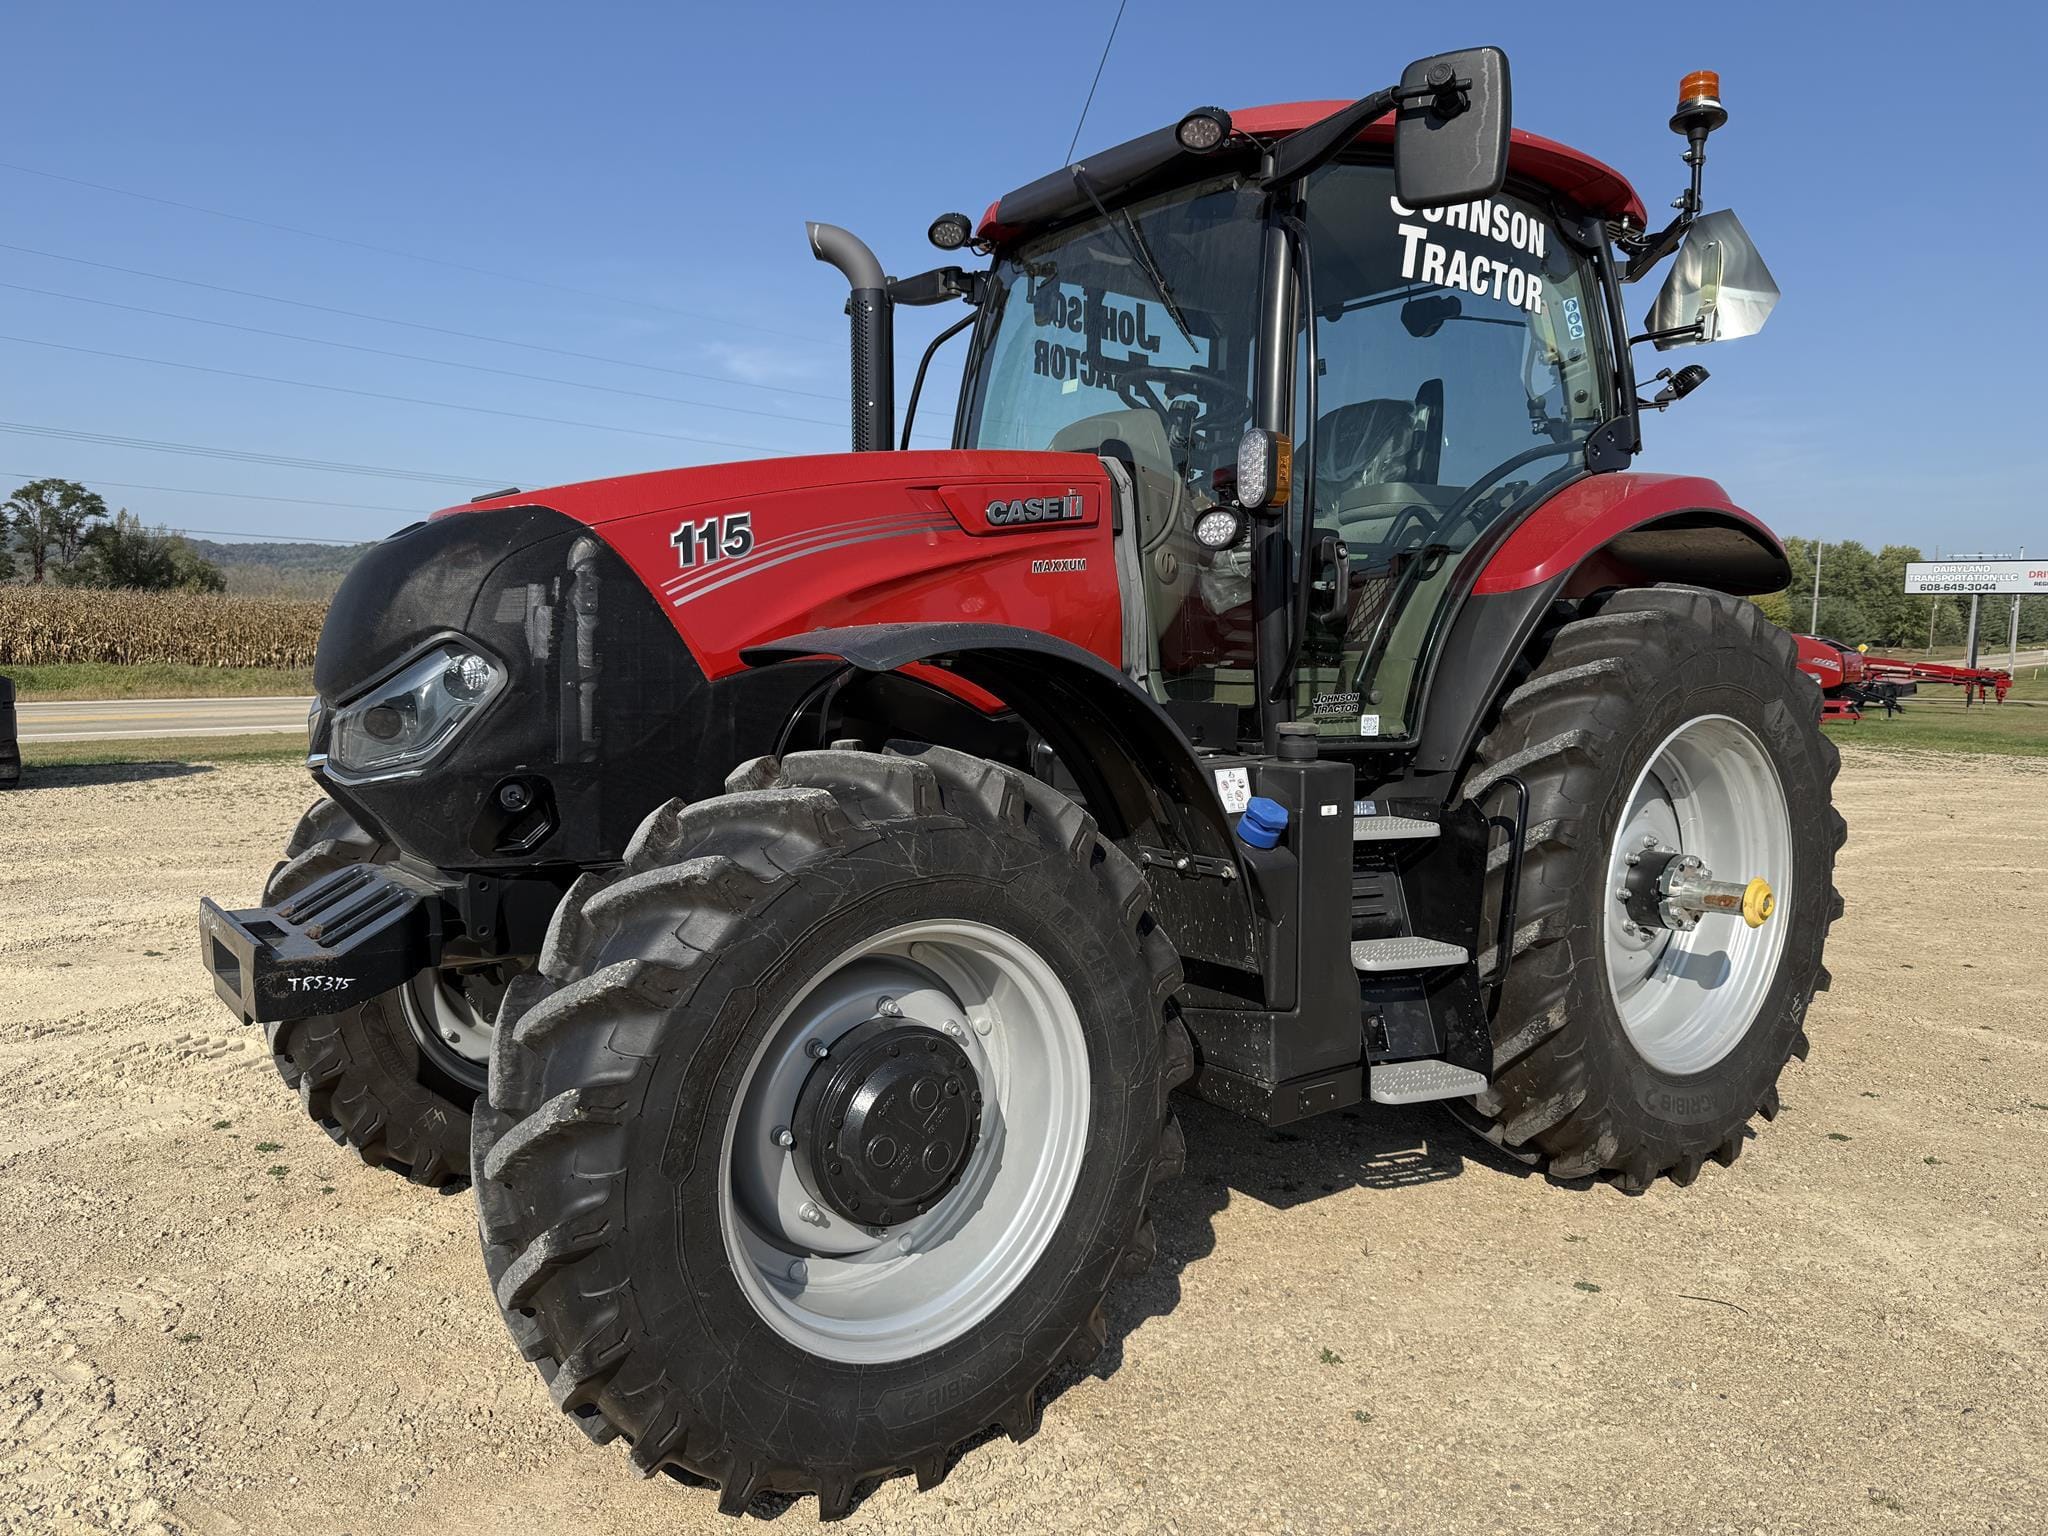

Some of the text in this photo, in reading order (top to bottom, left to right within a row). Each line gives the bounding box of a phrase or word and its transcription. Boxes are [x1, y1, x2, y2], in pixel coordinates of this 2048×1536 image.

[1398, 223, 1543, 314] TRACTOR
[986, 497, 1061, 526] CASE
[670, 512, 754, 568] 115
[1031, 558, 1087, 574] MAXXUM
[1933, 564, 1991, 573] DAIRYLAND
[1920, 583, 1996, 592] 608-649-3044
[1312, 692, 1360, 704] JOHNSON
[1313, 703, 1359, 714] TRACTOR
